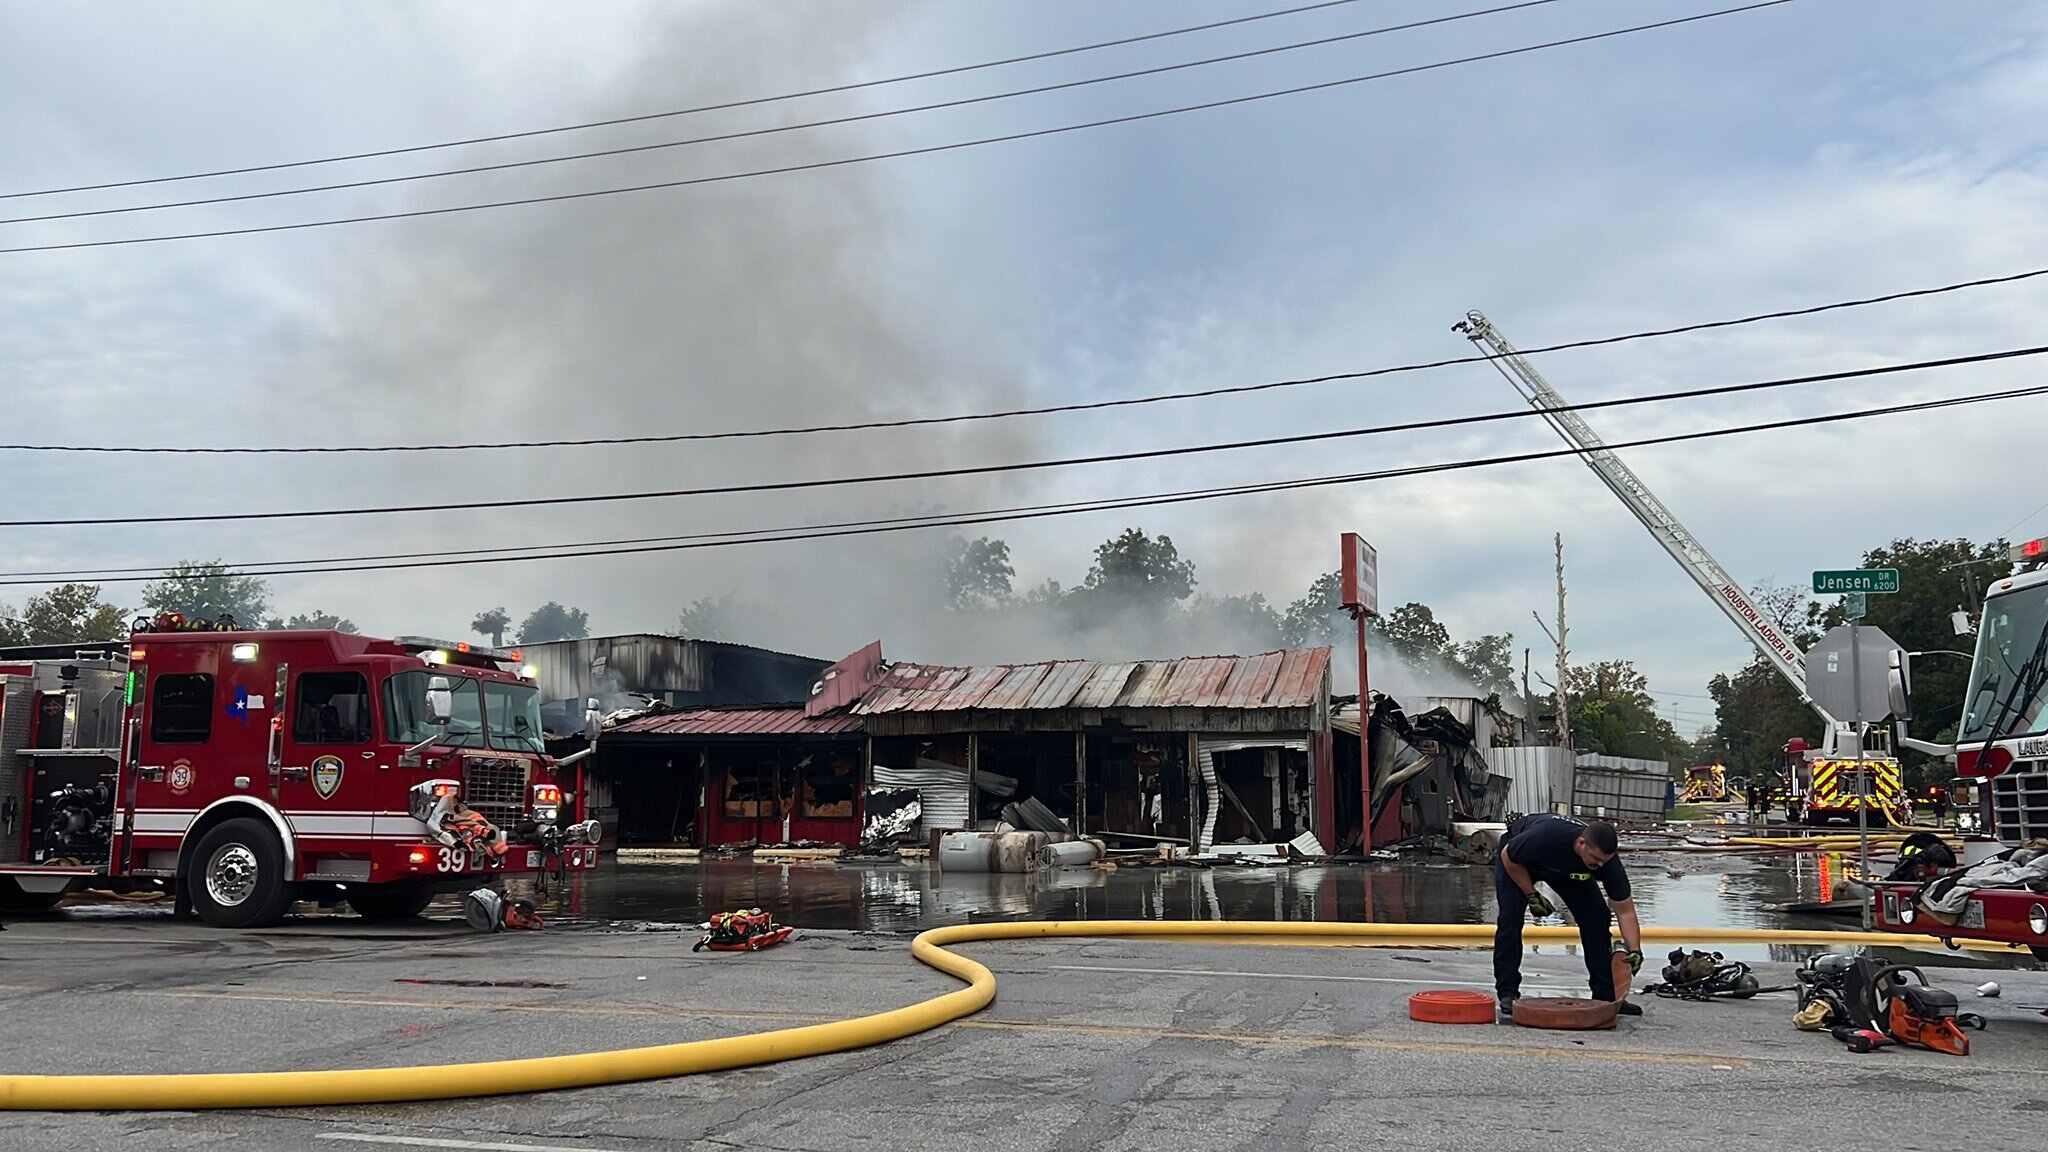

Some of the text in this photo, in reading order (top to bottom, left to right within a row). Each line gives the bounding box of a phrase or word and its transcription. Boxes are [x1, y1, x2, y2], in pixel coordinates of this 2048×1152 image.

[1818, 572, 1889, 589] Jensen DR
[1873, 582, 1895, 590] 6200
[1721, 585, 1795, 661] HOUSTON LADDER 19
[175, 771, 187, 783] 39
[437, 847, 466, 873] 39
